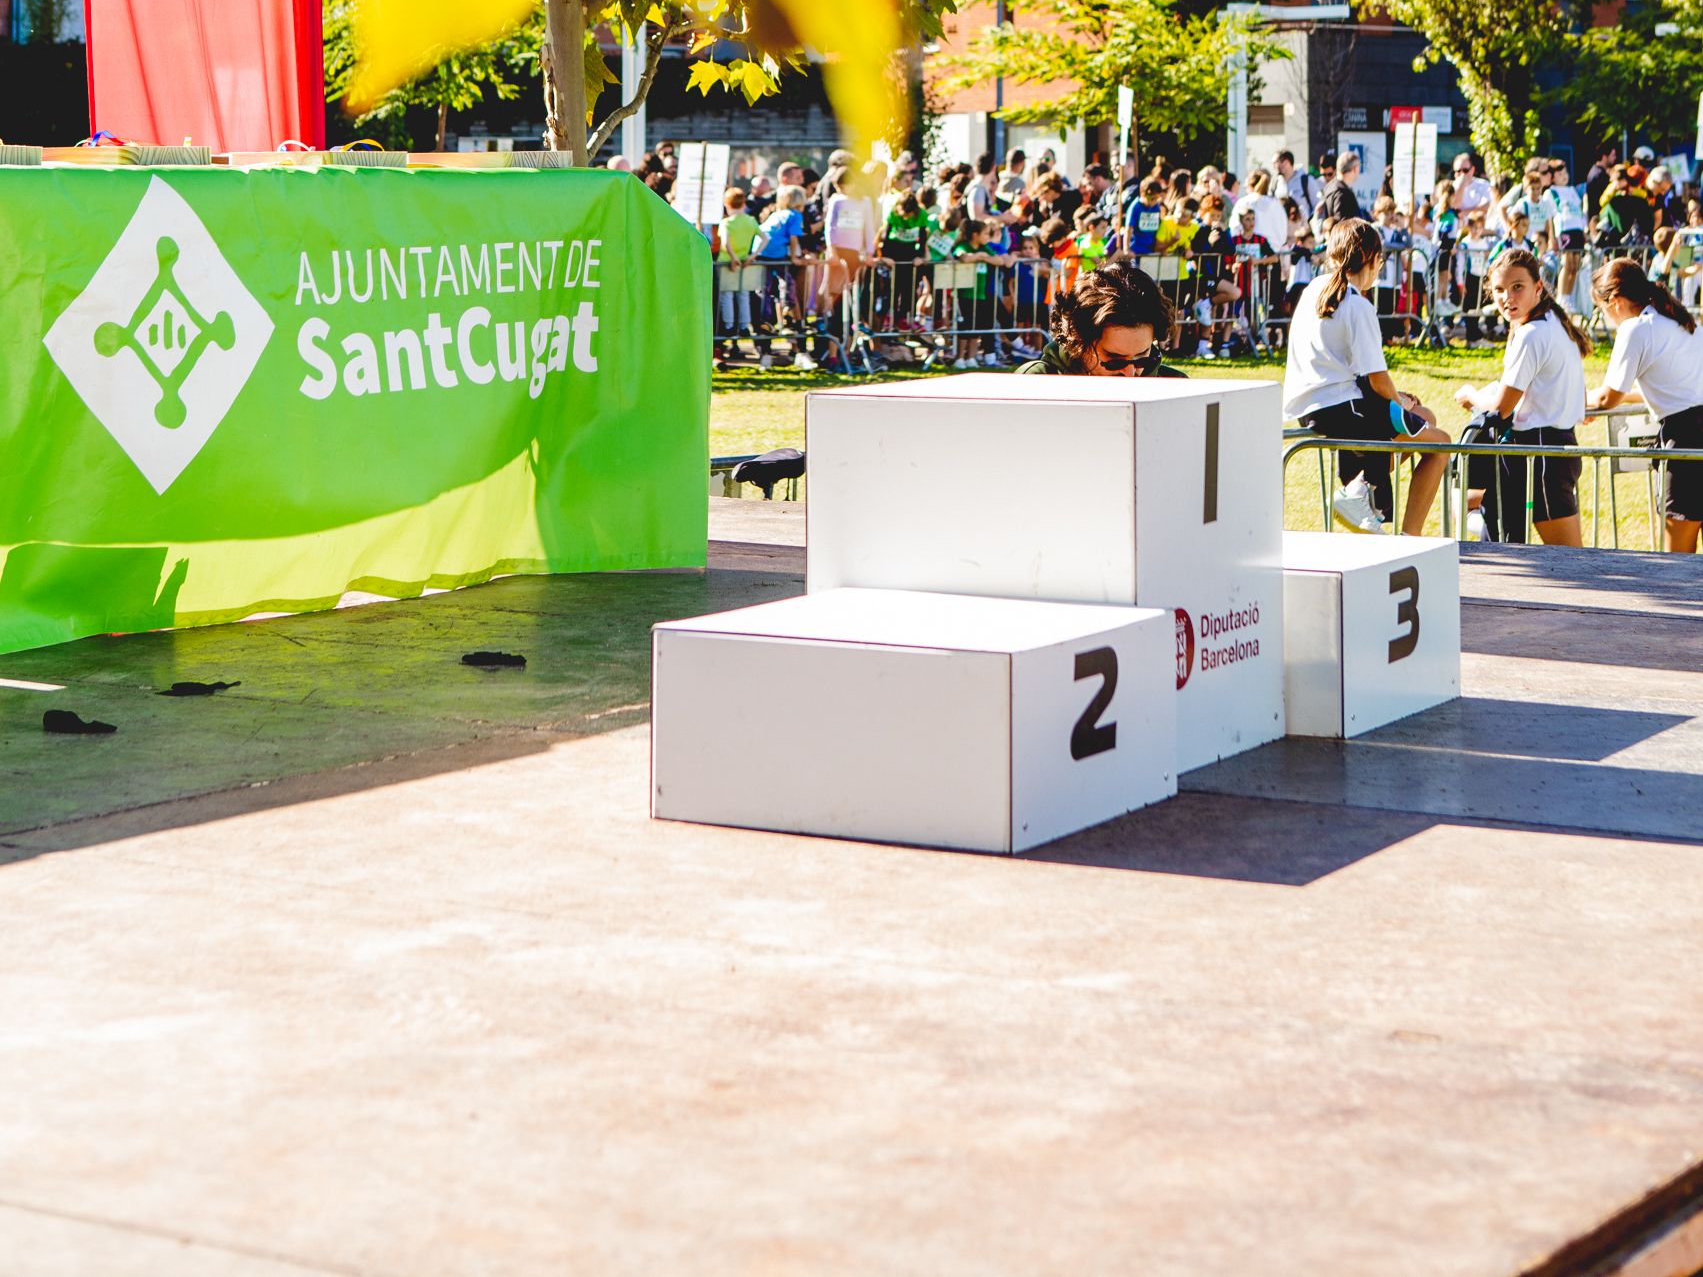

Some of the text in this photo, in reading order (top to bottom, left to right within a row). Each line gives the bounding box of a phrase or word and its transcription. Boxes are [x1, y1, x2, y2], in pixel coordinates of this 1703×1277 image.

[295, 239, 602, 305] AJUNTAMENT DE
[1203, 402, 1219, 525] 1
[1200, 601, 1260, 640] Diputació
[1201, 638, 1260, 671] Barcelona
[1388, 565, 1420, 664] 3
[1070, 646, 1118, 761] 2
